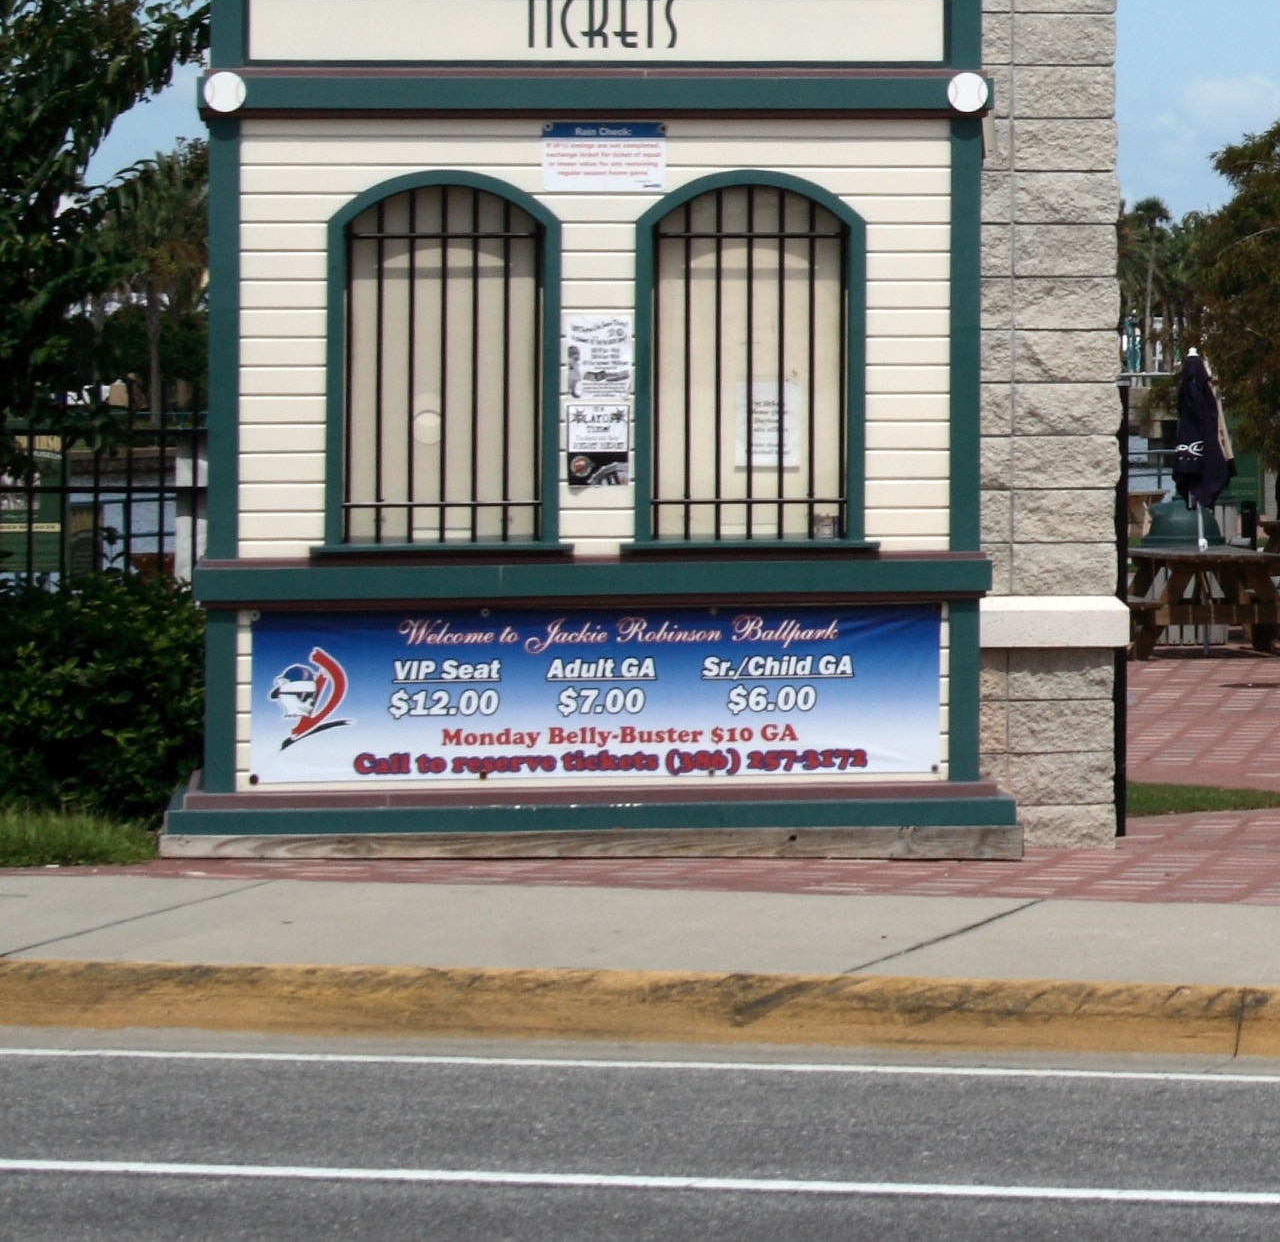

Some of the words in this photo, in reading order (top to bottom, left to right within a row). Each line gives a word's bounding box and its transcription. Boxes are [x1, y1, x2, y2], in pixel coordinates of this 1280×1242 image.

[399, 618, 494, 646] Welcome
[499, 626, 519, 644] to
[524, 618, 609, 655] Jackie
[616, 617, 722, 644] Robinson
[732, 615, 838, 650] Ballpark
[393, 659, 436, 681] VIP
[440, 658, 501, 680] Seat
[546, 657, 616, 680] Adult
[620, 656, 657, 679] GA
[702, 654, 813, 680] Sr./Child
[818, 654, 853, 676] GA
[389, 686, 500, 718] $12.00
[557, 686, 645, 717] $7.00
[727, 683, 817, 715] $6.00
[441, 727, 540, 748] Monday
[548, 725, 704, 747] Belly-Buster
[711, 725, 754, 744] $10
[760, 723, 799, 743] GA
[353, 752, 411, 774] Call
[415, 754, 448, 774] to
[452, 753, 557, 774] reserve
[561, 750, 660, 772] tickets
[746, 747, 869, 772] 257-3172
